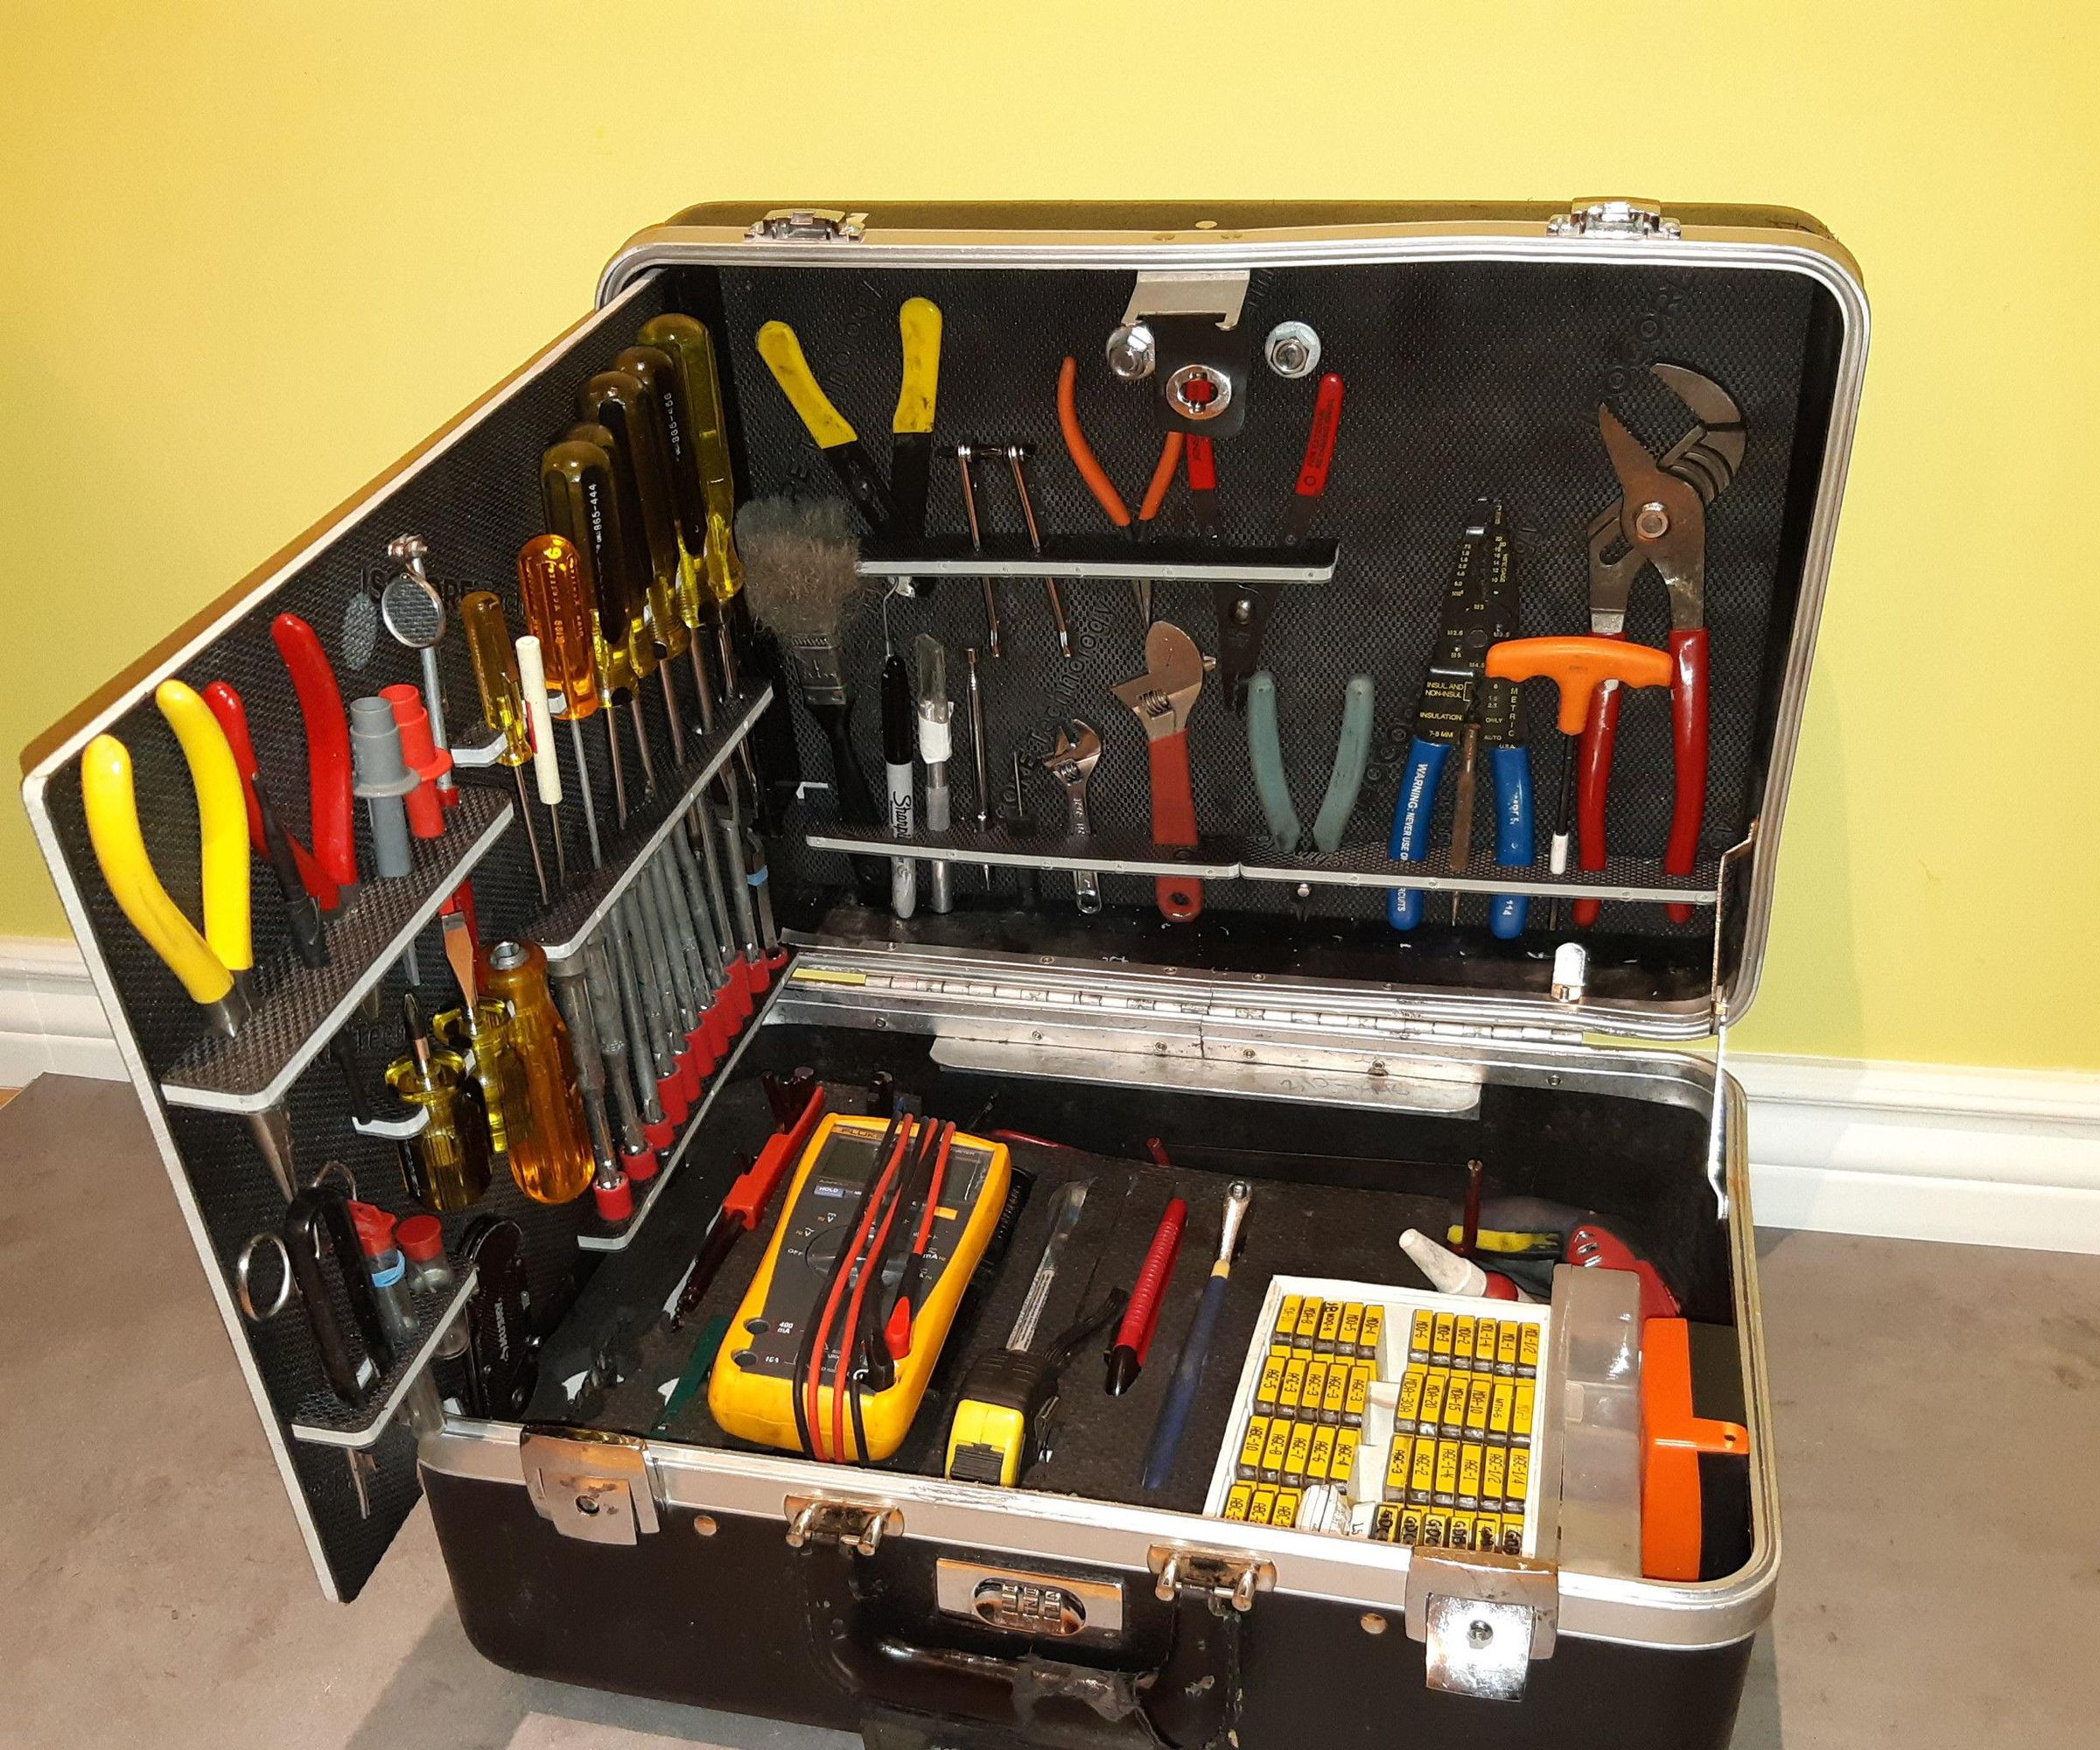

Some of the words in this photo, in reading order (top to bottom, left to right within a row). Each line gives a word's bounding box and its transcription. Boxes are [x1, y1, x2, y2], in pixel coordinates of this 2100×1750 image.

[1419, 712, 1463, 721] INSULATION
[1508, 688, 1519, 737] METRIC
[1407, 764, 1428, 812] WARNING:
[892, 790, 912, 839] Sharpi
[1402, 812, 1416, 836] NEVER
[1400, 836, 1411, 851] USE
[788, 1248, 803, 1256] OFF
[1306, 1374, 1321, 1396] AGC-3
[1326, 1376, 1341, 1398] AGC-3
[1350, 1379, 1365, 1402] AGC-3
[1399, 1378, 1418, 1413] MDA-30A
[1246, 1426, 1263, 1451] AGC-10
[1290, 1437, 1306, 1460] AGC-7
[1391, 1449, 1405, 1474] AGC-3
[1415, 1453, 1431, 1476] AGC-2
[1488, 1453, 1502, 1484] AGC-1/2
[1511, 1454, 1528, 1484] AGC-1/4
